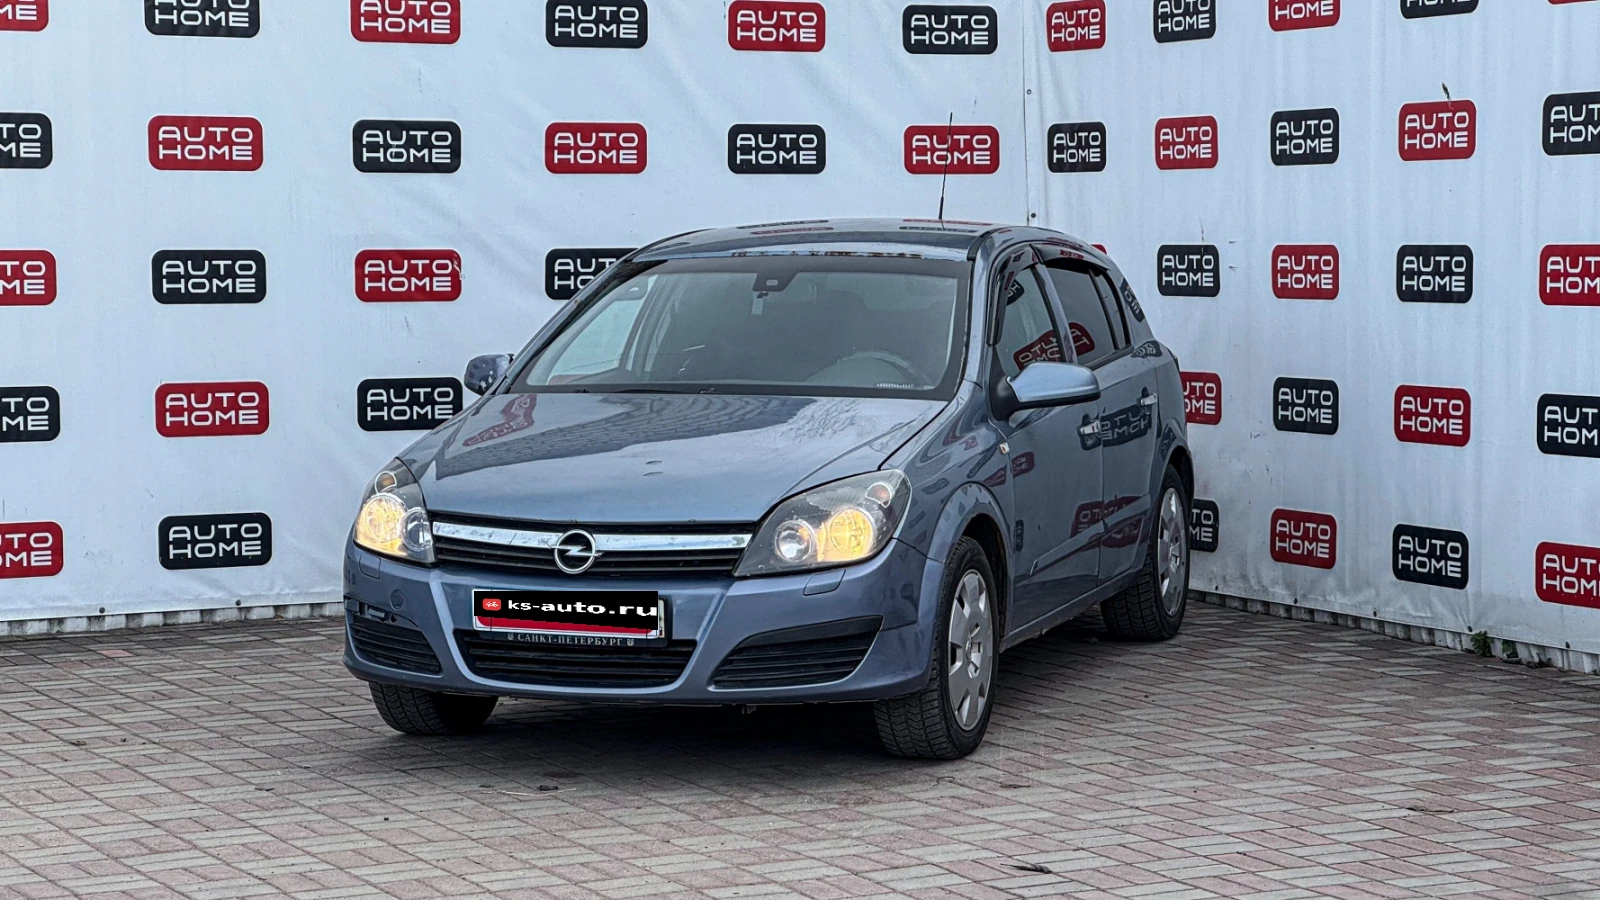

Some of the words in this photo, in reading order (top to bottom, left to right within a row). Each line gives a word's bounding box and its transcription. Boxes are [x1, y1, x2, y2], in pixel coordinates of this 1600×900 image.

[361, 0, 451, 16] AUTO
[555, 6, 639, 21] AUTO
[1275, 0, 1334, 20] HOME
[155, 9, 249, 27] HOME
[361, 17, 450, 33] HOME
[737, 10, 817, 25] AUTO
[911, 15, 989, 28] AUTO
[1052, 9, 1100, 25] AUTO
[1159, 14, 1209, 32] HOME
[555, 23, 638, 38] HOME
[737, 27, 816, 42] HOME
[911, 31, 988, 44] HOME
[1052, 25, 1100, 42] HOME
[1276, 120, 1333, 136] AUTO
[1405, 112, 1469, 130] AUTO
[159, 127, 253, 142] AUTO
[363, 130, 452, 146] AUTO
[555, 133, 638, 147] AUTO
[737, 134, 817, 147] AUTO
[912, 135, 991, 148] AUTO
[1054, 132, 1100, 146] AUTO
[1160, 126, 1212, 142] AUTO
[1405, 131, 1468, 149] HOME
[159, 145, 252, 160] HOME
[1161, 144, 1211, 159] HOME
[1276, 138, 1332, 154] HOME
[363, 148, 450, 162] HOME
[554, 150, 637, 163] HOME
[737, 151, 816, 164] HOME
[913, 151, 990, 164] HOME
[1054, 148, 1100, 163] HOME
[163, 261, 256, 275] AUTO
[365, 260, 452, 274] AUTO
[1163, 255, 1214, 269] AUTO
[1278, 256, 1333, 270] AUTO
[1403, 256, 1466, 272] AUTO
[163, 278, 255, 293] HOME
[365, 277, 451, 291] HOME
[1163, 272, 1213, 286] HOME
[1278, 274, 1332, 288] HOME
[1403, 275, 1465, 291] HOME
[166, 392, 259, 408] AUTO
[367, 388, 453, 403] AUTO
[1279, 388, 1332, 405] AUTO
[367, 405, 453, 420] HOME
[1401, 397, 1463, 415] AUTO
[166, 410, 258, 426] HOME
[1279, 406, 1331, 423] HOME
[1401, 415, 1462, 434] HOME
[169, 523, 262, 541] AUTO
[1277, 520, 1330, 539] AUTO
[0, 533, 53, 549] TO
[1276, 537, 1329, 558] HOME
[1399, 536, 1461, 558] AUTO
[170, 541, 261, 559] HOME
[0, 551, 52, 567] ME
[1399, 554, 1461, 577] HOME
[1543, 554, 1600, 575] AUT
[1543, 574, 1600, 596] HOM
[517, 634, 622, 646] САНКТ-ПЕТЕРБУРГ
